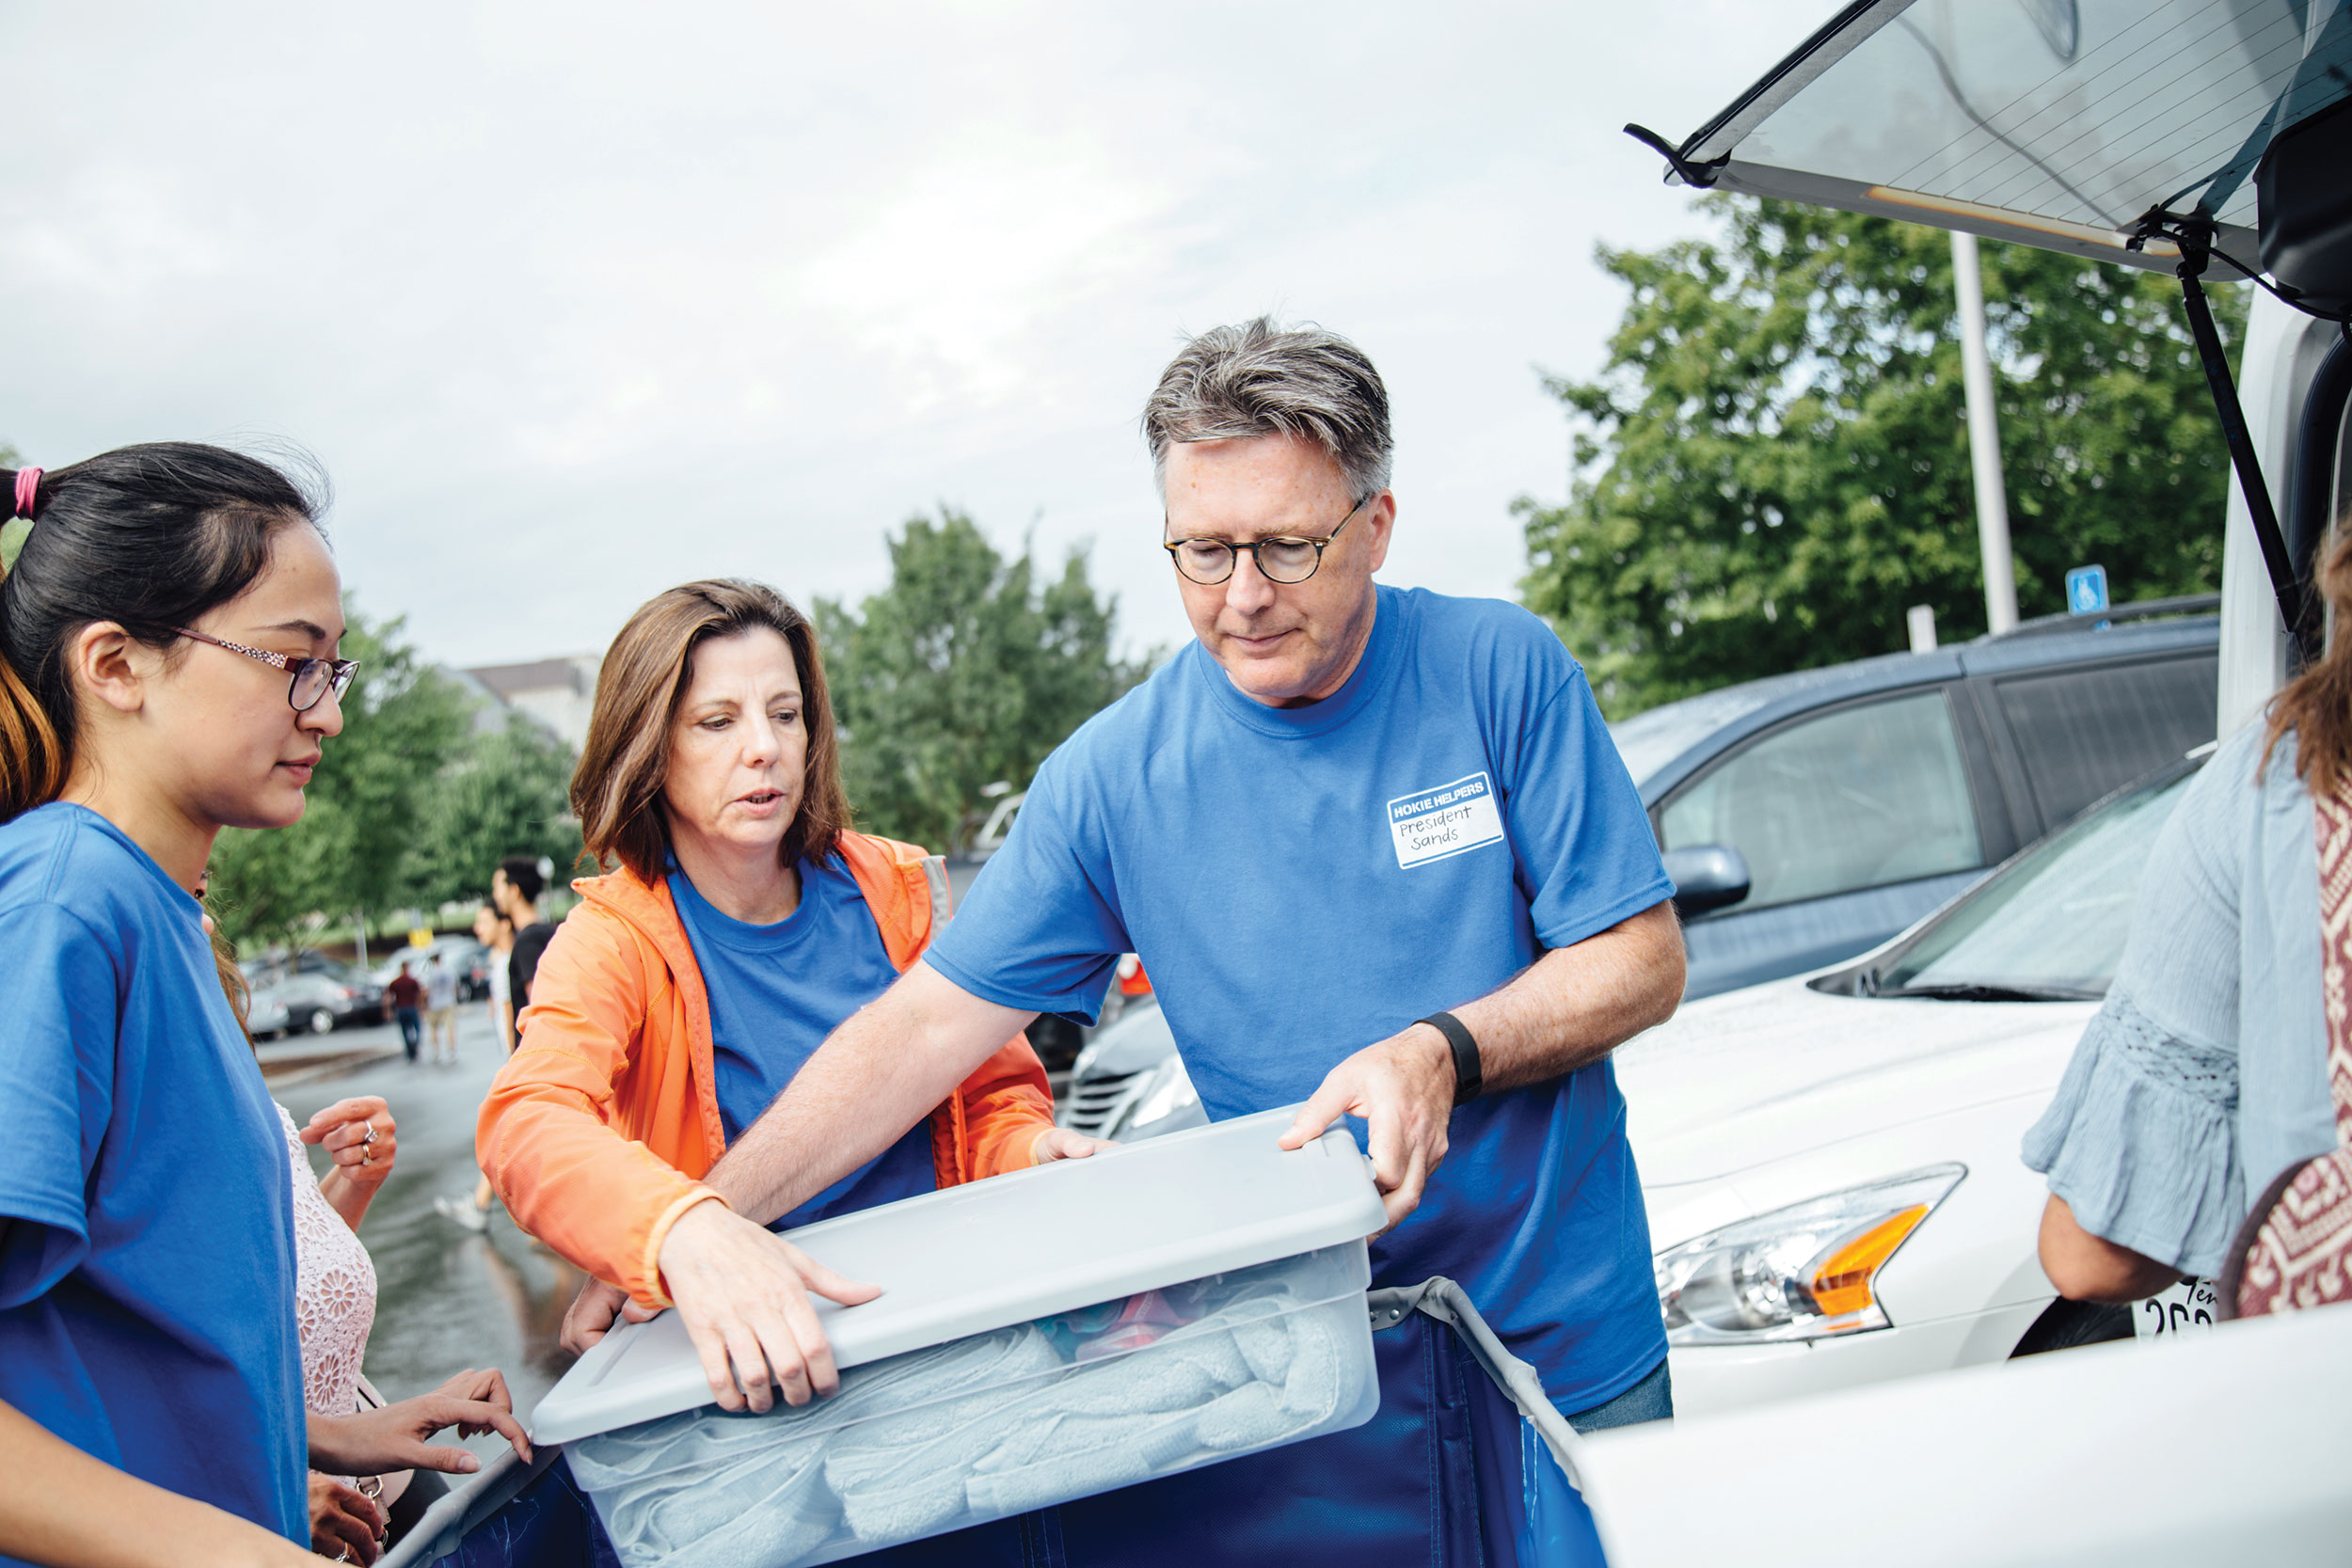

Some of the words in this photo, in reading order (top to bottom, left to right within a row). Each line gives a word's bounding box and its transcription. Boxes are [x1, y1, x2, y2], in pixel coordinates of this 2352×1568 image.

[1394, 798, 1434, 818] HOKIE
[1434, 782, 1485, 807] HELPERS
[1399, 806, 1472, 837] President
[1411, 828, 1458, 850] Sands
